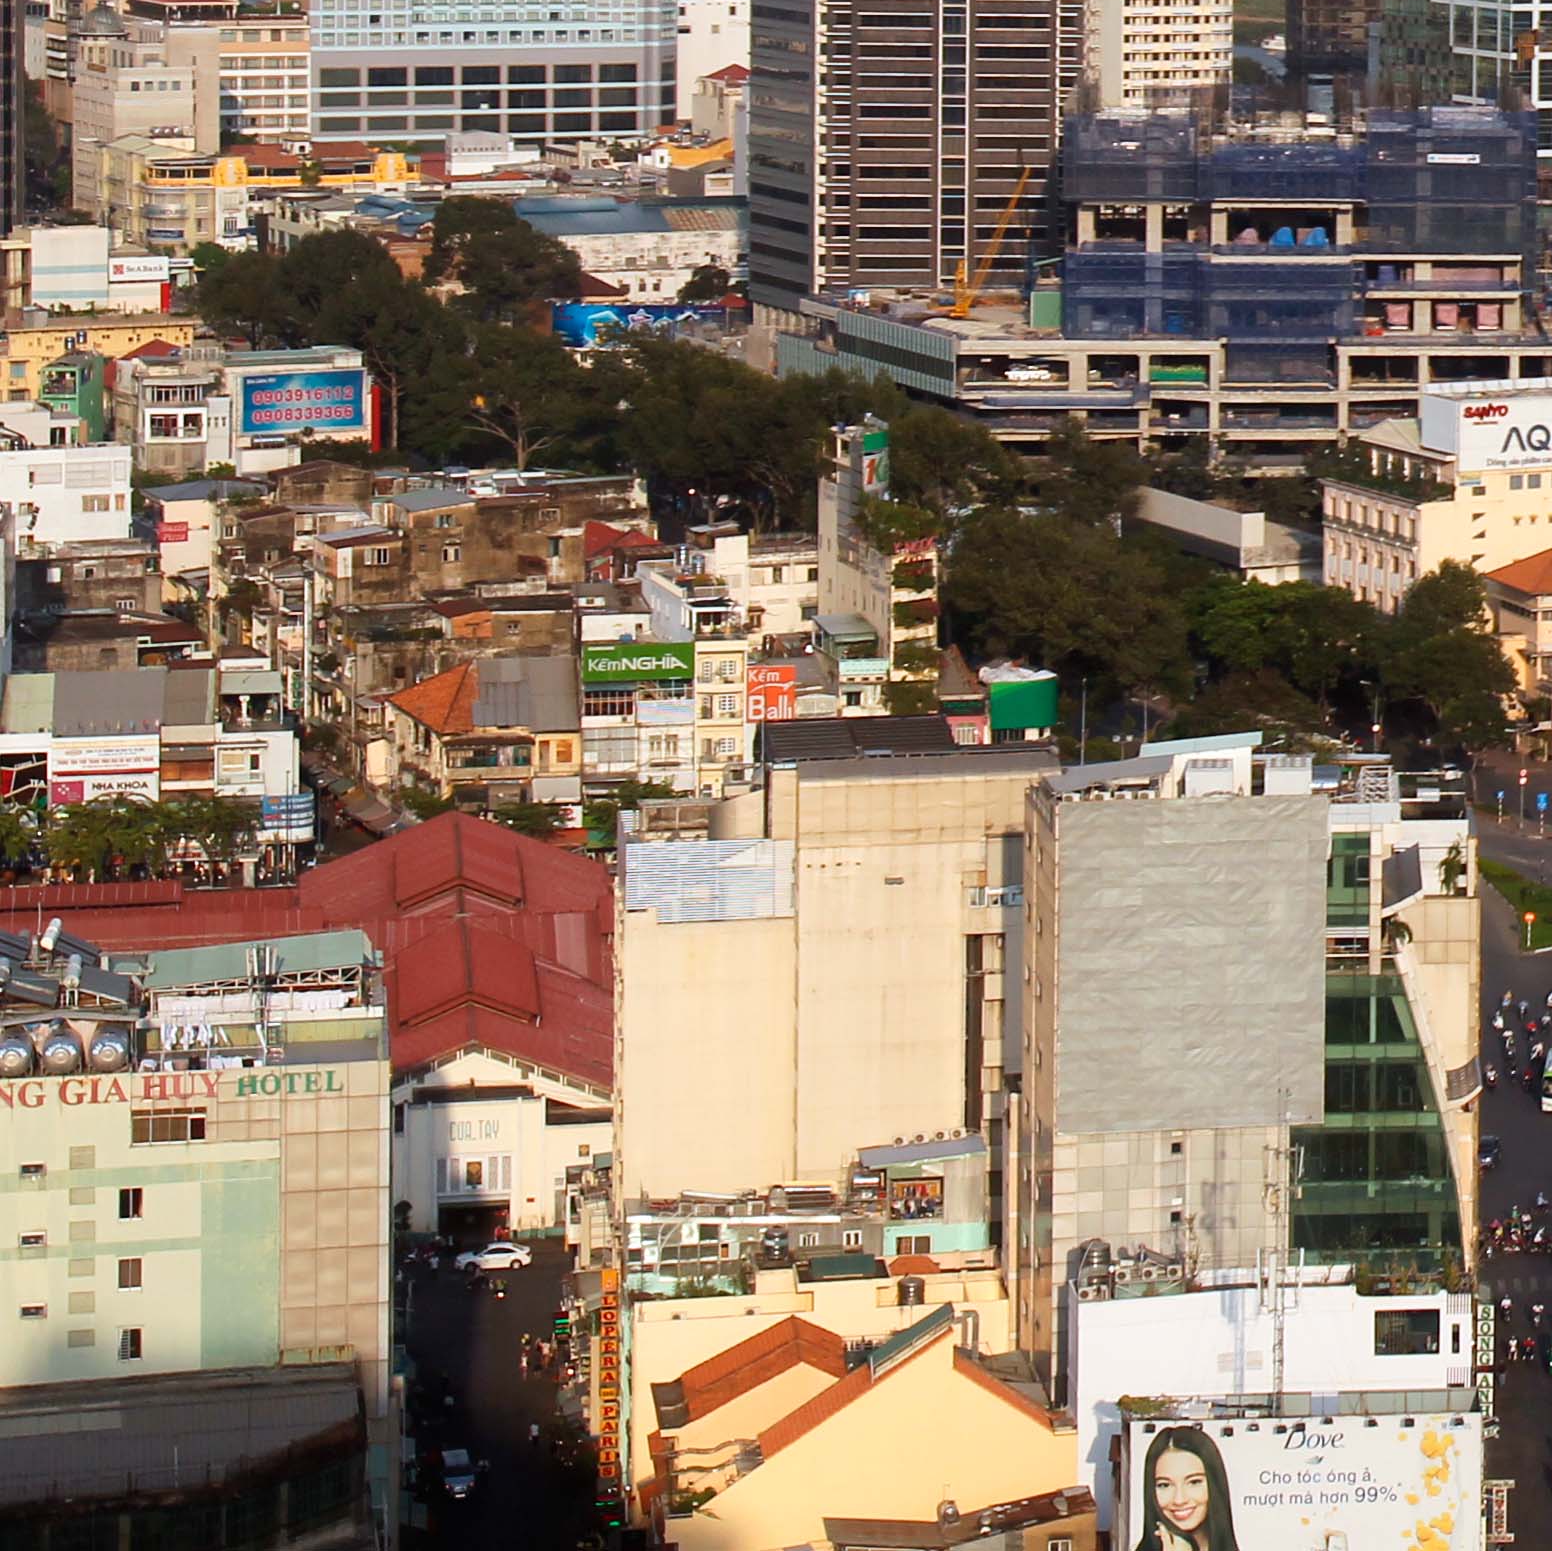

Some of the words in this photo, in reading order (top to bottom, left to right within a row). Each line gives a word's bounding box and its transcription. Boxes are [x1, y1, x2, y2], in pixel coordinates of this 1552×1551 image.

[1463, 403, 1509, 420] SANYO
[92, 781, 114, 790] NHA
[117, 780, 149, 790] KHOA
[58, 1076, 129, 1106] GIA
[141, 1071, 224, 1101] HUY
[236, 1070, 344, 1097] HOTEL
[1480, 1306, 1491, 1365] SONG
[1480, 1374, 1493, 1417] ANH
[602, 1406, 615, 1477] PARIS
[1283, 1429, 1345, 1450] Dove
[1259, 1470, 1292, 1485] Cho
[1297, 1468, 1322, 1484] tóc
[1327, 1468, 1357, 1488] óng
[1243, 1492, 1284, 1508] mượt
[1319, 1490, 1349, 1505] hơn
